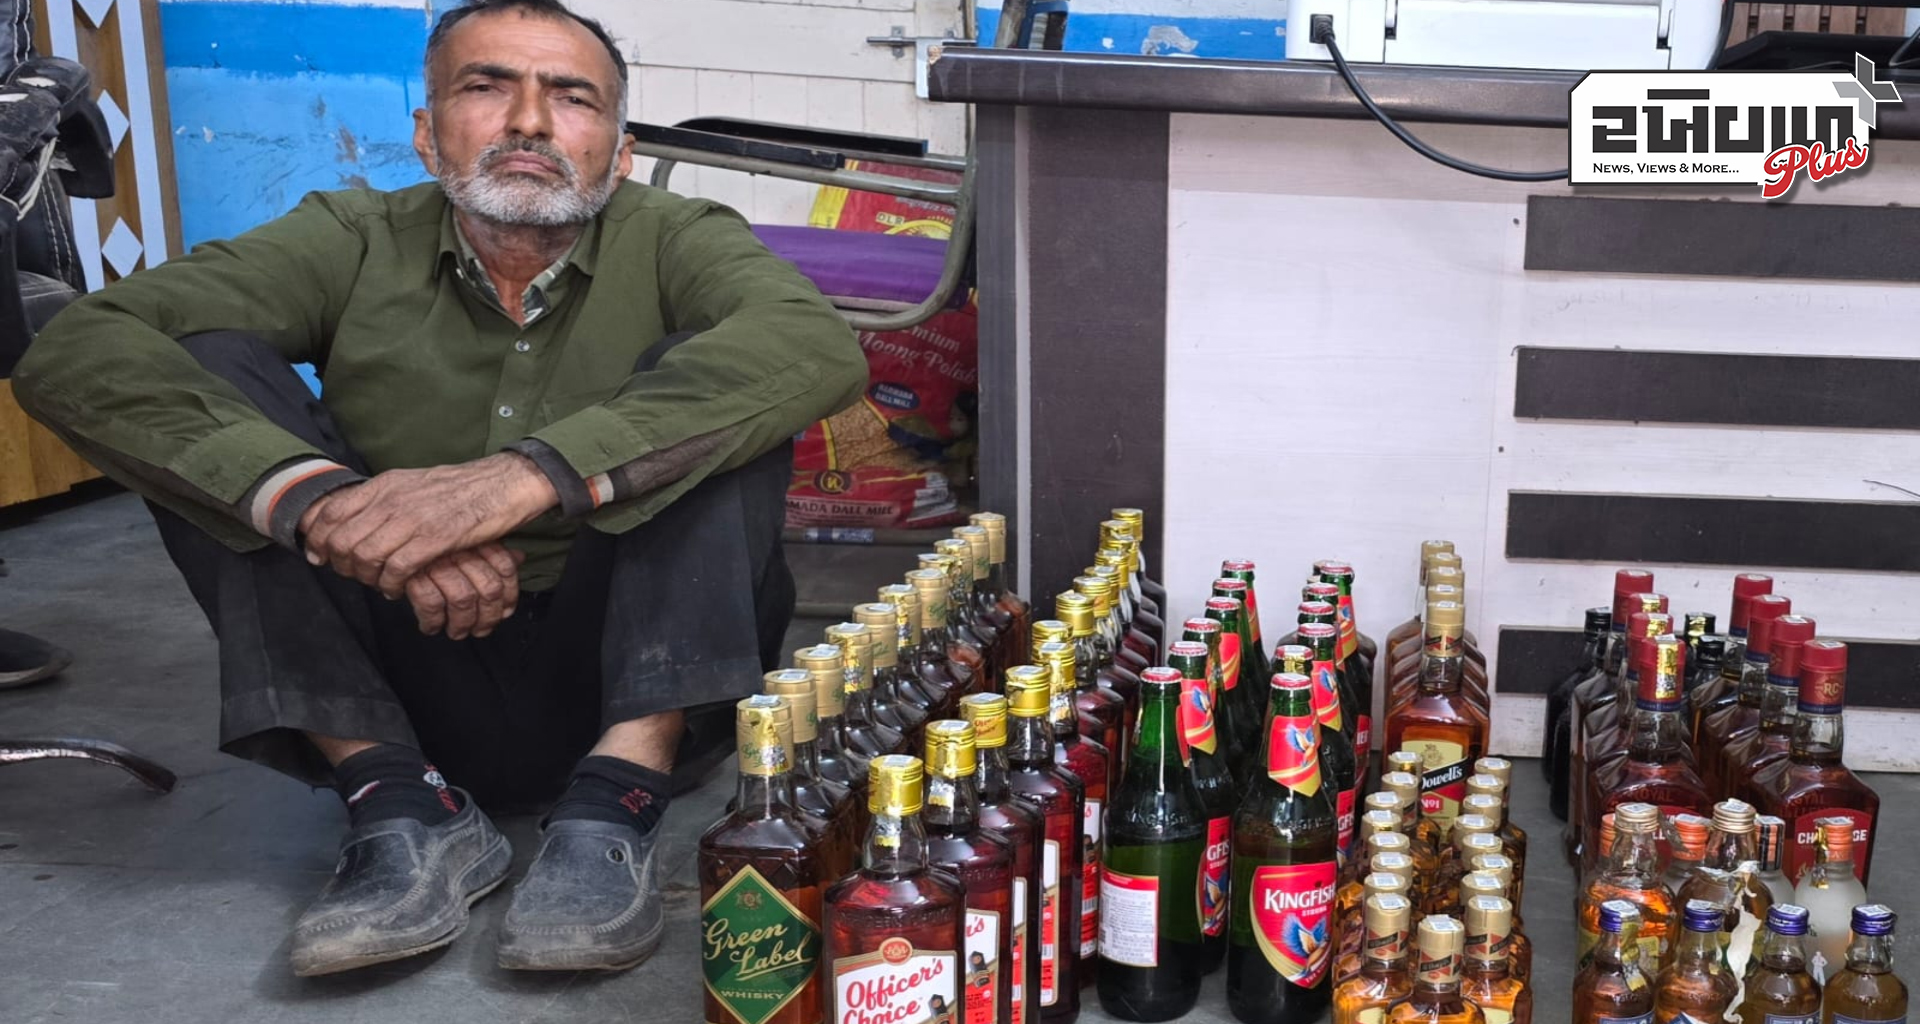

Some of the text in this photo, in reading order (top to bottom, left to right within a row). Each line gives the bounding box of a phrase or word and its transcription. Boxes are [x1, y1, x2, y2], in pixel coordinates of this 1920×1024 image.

[831, 504, 862, 515] DALL
[702, 918, 789, 960] Green
[730, 931, 814, 976] Label
[721, 990, 785, 999] WHISKY
[846, 958, 943, 1010] Officer's
